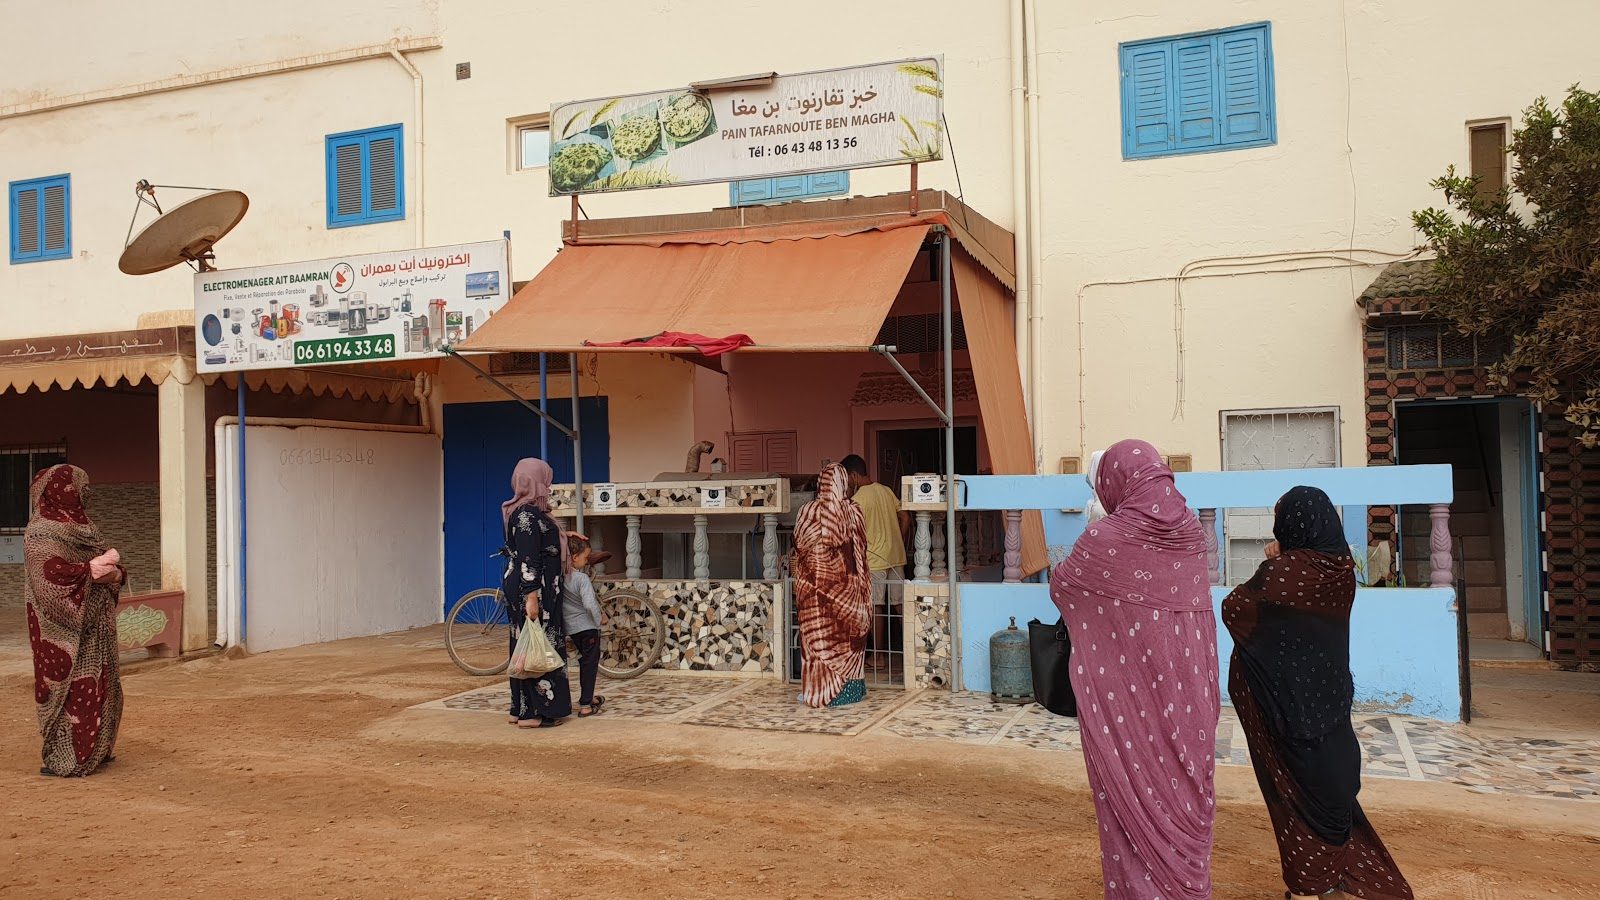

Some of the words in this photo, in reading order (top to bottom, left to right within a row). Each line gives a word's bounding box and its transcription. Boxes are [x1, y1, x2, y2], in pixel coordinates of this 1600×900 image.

[849, 85, 878, 109] خبز
[731, 99, 757, 117] مغا
[762, 99, 780, 118] بن
[721, 127, 747, 140] PAIN
[749, 119, 822, 138] TAFARNOUTE
[825, 116, 848, 130] BEN
[851, 111, 896, 127] MAGHA
[748, 147, 764, 158] Tél
[774, 144, 788, 155] 06
[791, 142, 805, 154] 43
[808, 140, 822, 152] 48
[826, 138, 840, 150] 13
[843, 136, 858, 148] 56
[360, 263, 396, 278] بعمران
[398, 256, 416, 273] أيت
[418, 252, 471, 271] إلكترونيك
[203, 277, 274, 292] ELECTROMENAGER
[275, 275, 288, 285] AIT
[290, 271, 329, 284] BAAMRAN
[297, 344, 314, 360] 06
[354, 340, 371, 355] 33
[374, 338, 392, 354] 48
